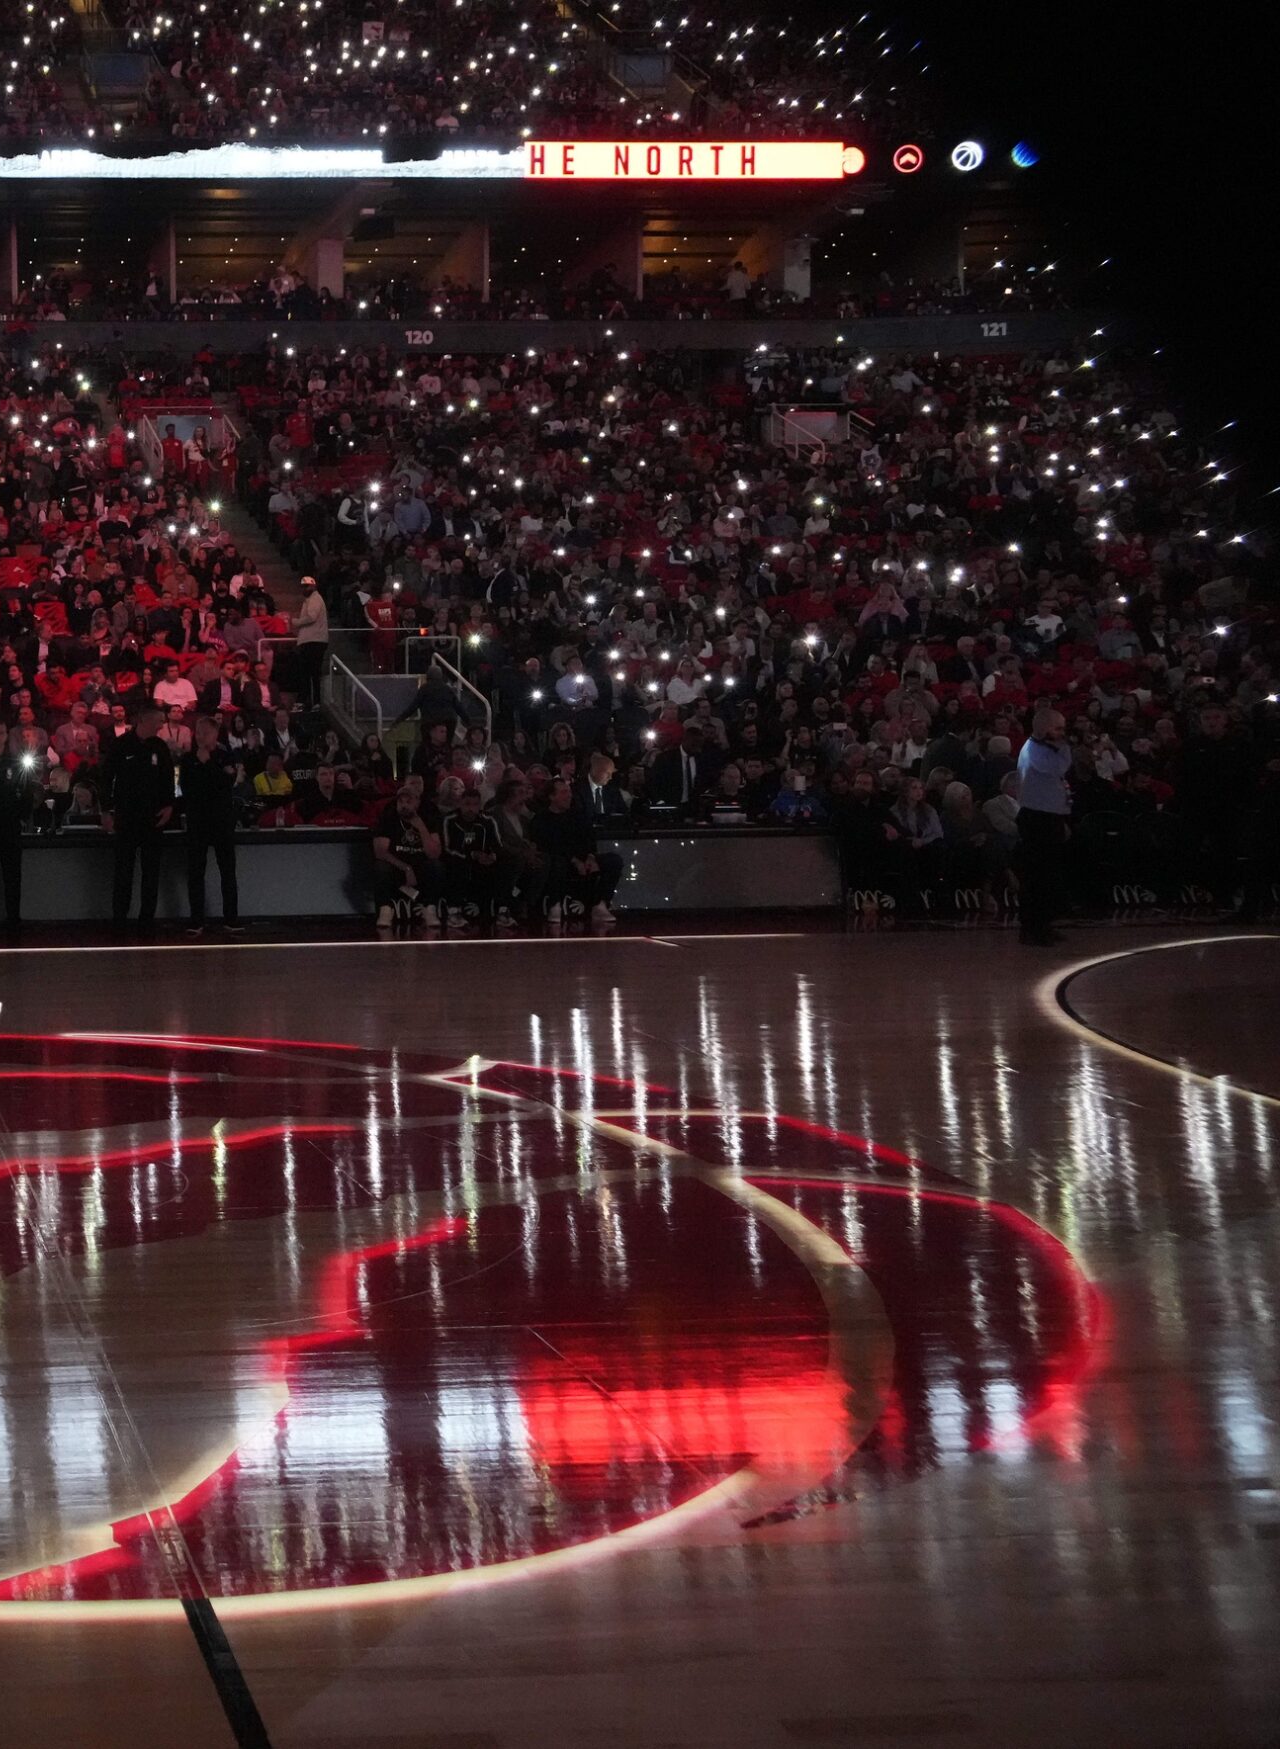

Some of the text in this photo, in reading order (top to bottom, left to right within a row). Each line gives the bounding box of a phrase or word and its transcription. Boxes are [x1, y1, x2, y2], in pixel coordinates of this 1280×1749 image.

[614, 145, 757, 176] NORTH
[405, 329, 434, 345] 120
[980, 321, 1008, 337] 121
